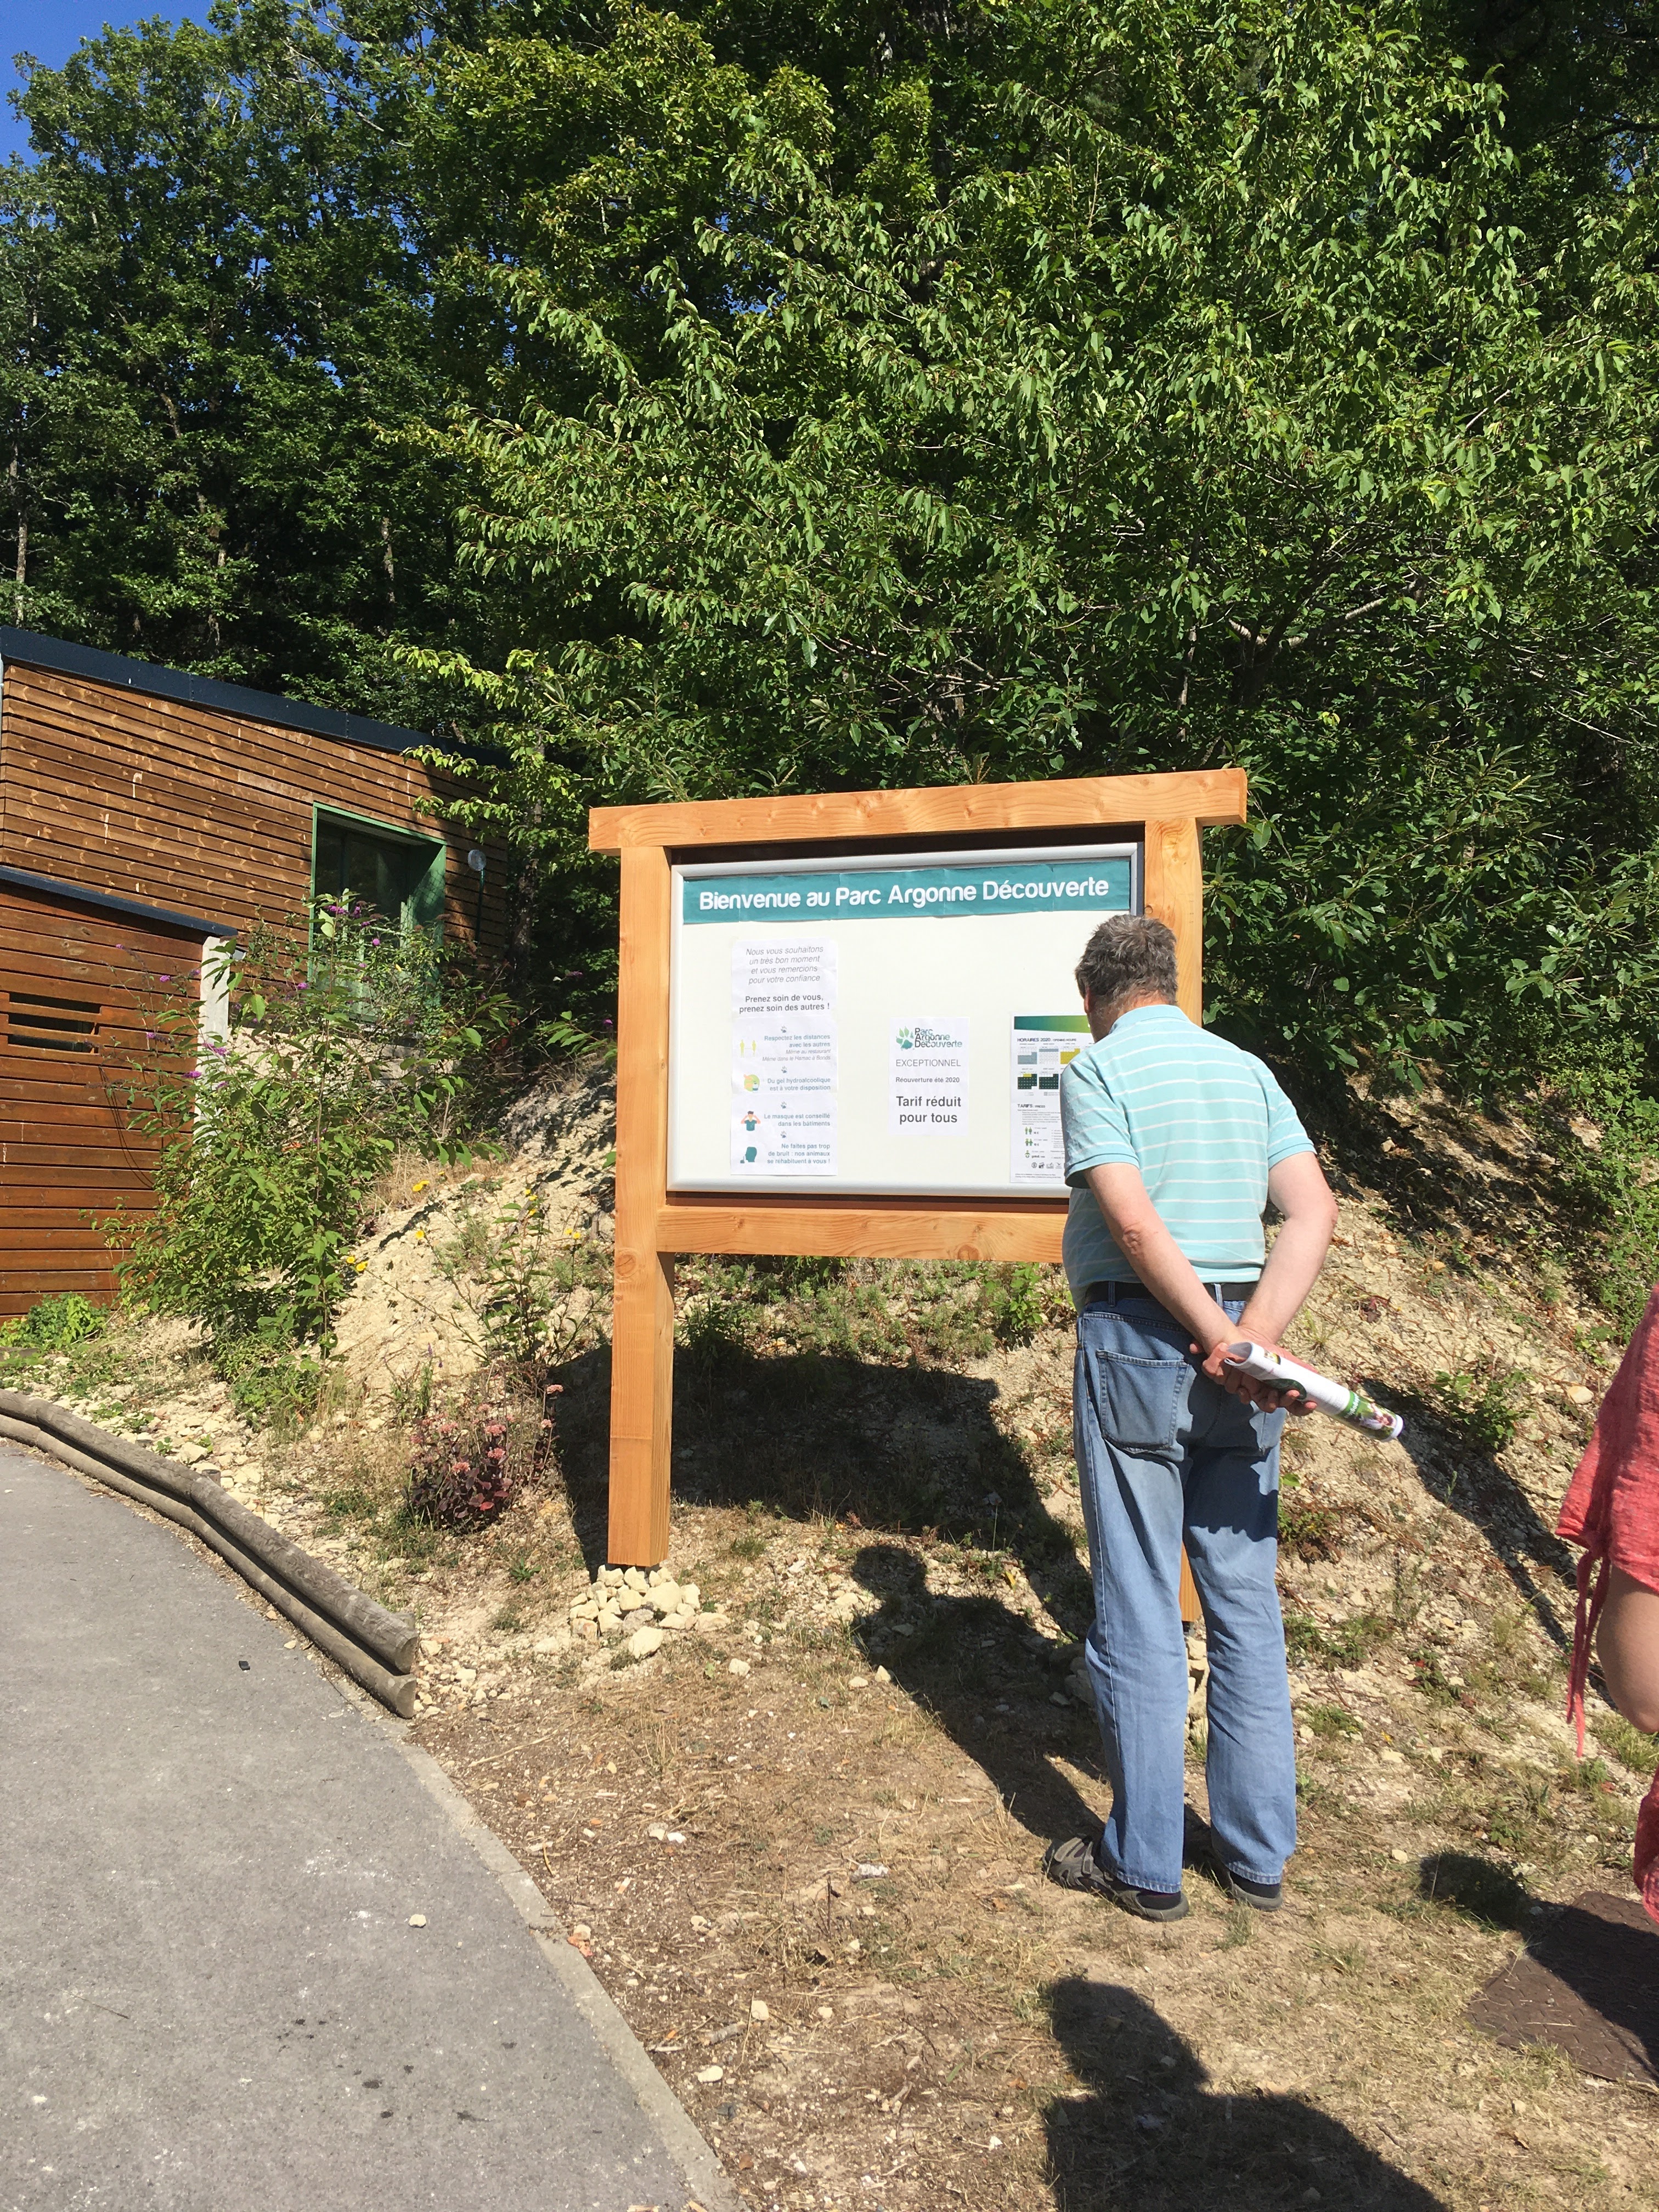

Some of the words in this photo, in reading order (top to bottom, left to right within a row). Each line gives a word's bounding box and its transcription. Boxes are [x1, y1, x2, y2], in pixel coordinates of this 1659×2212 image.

[699, 891, 801, 910] Bienvenue
[806, 891, 830, 907] au
[836, 887, 881, 906] Parc
[887, 885, 977, 909] Argonne
[983, 877, 1109, 900] Découverte
[748, 977, 765, 985] pour
[740, 1006, 764, 1014] prenez
[915, 1034, 950, 1042] Argonne
[896, 1096, 922, 1107] Tarif
[926, 1096, 961, 1107] réduit
[900, 1114, 927, 1125] pour
[931, 1113, 957, 1122] tous
